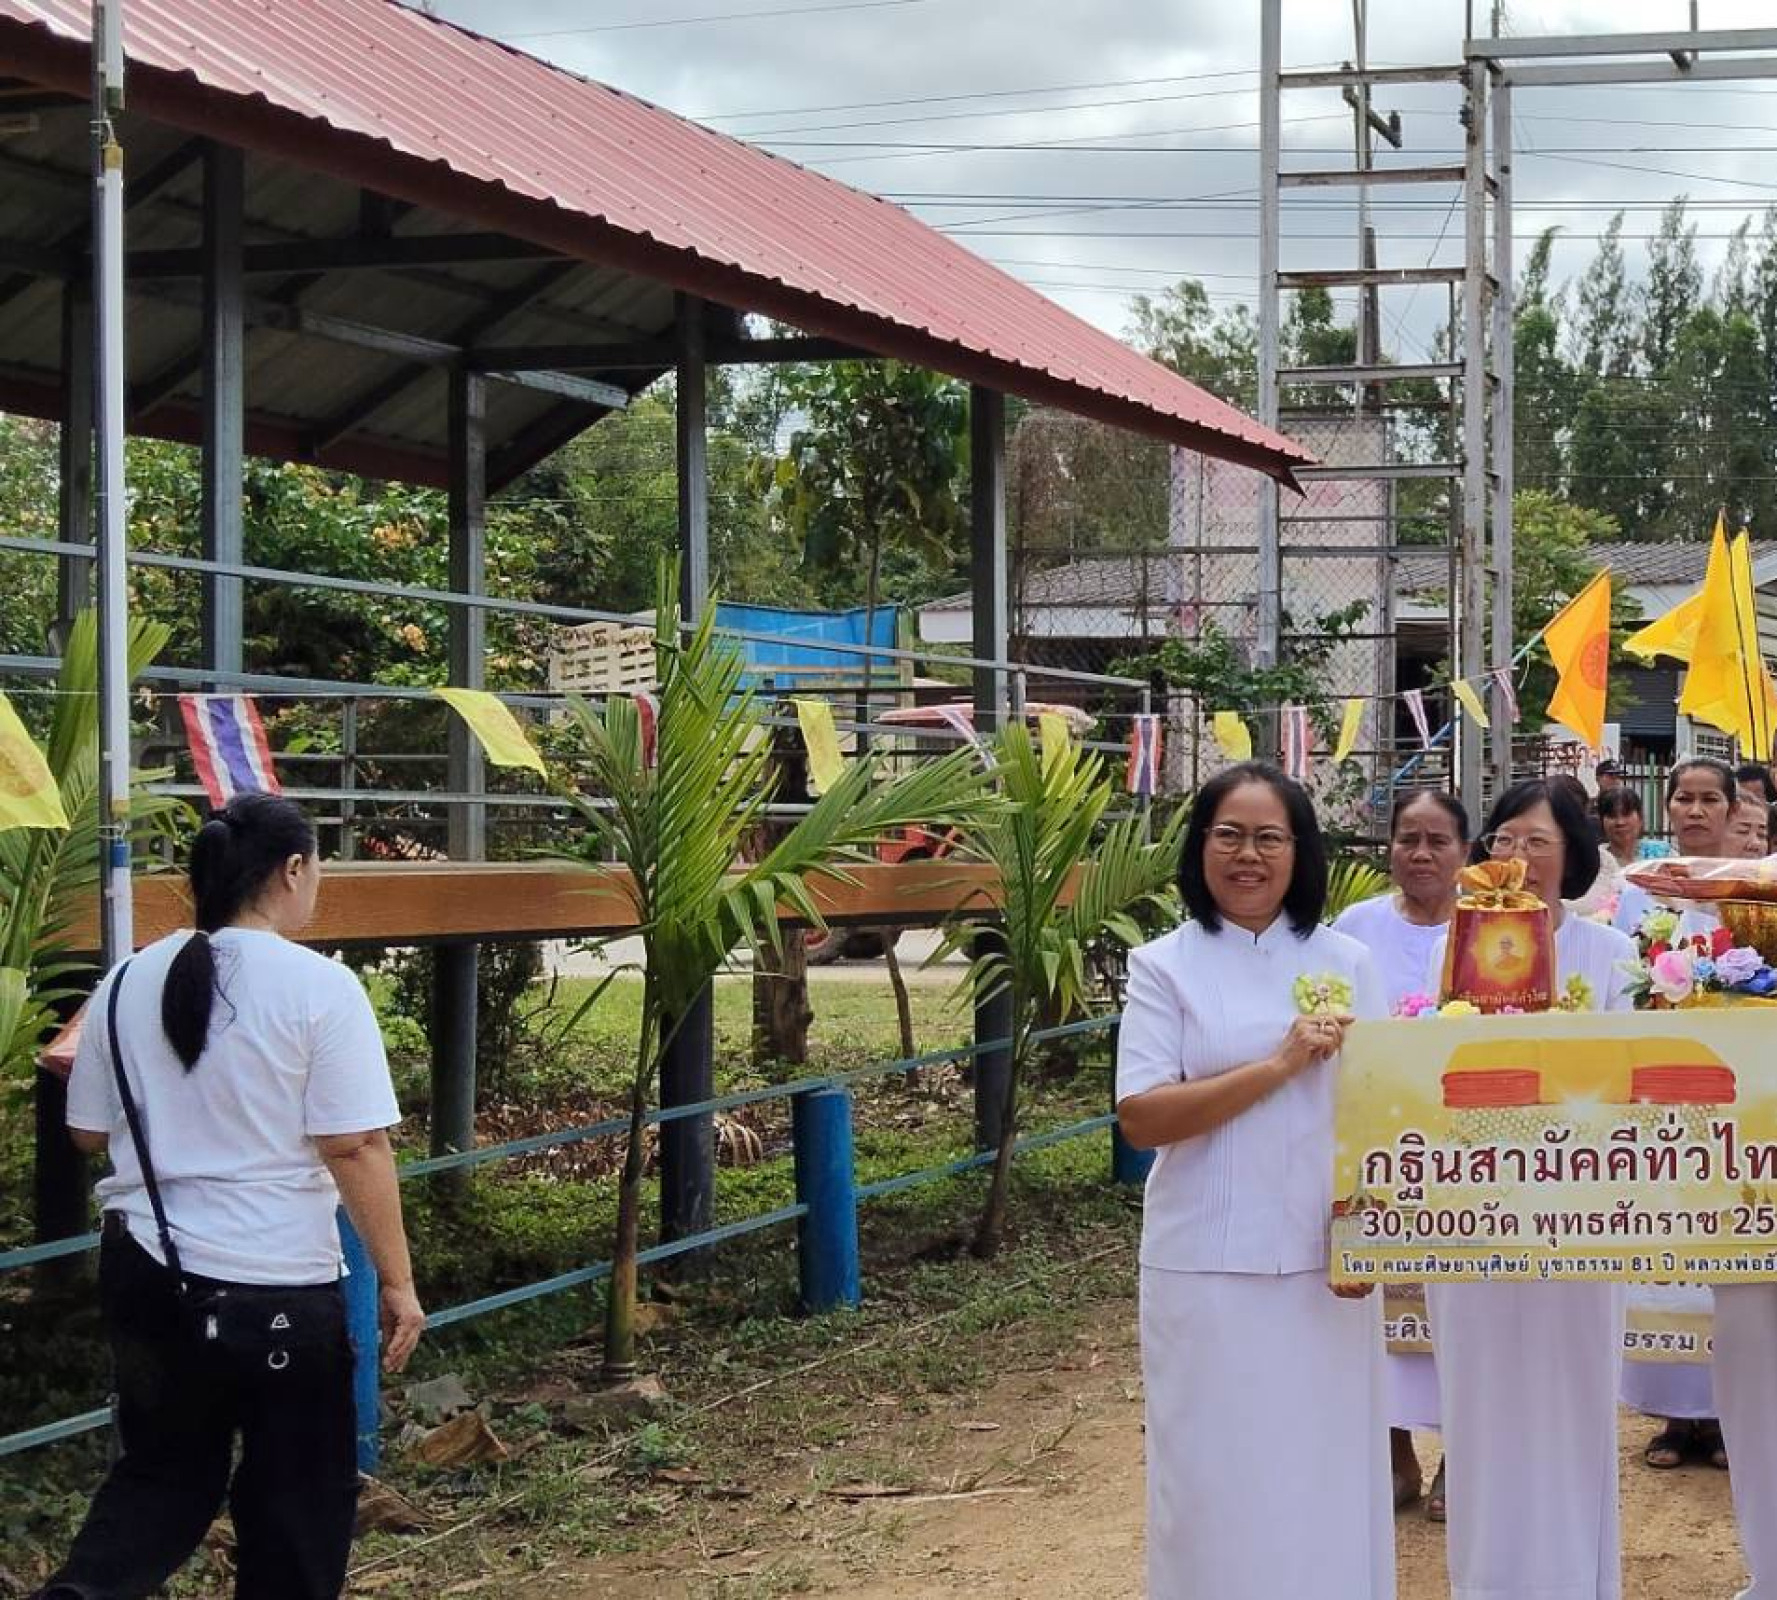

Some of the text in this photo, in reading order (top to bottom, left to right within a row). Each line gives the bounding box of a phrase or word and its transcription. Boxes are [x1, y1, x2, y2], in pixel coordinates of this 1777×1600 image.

[1363, 1202, 1520, 1242] 30,000วัด
[1532, 1200, 1719, 1248] พุทธศักราช
[1342, 1253, 1376, 1273] โดย
[1382, 1253, 1530, 1278] คณะศิษยานุศิษย์
[1538, 1258, 1624, 1278] บูชาธรรม
[1631, 1255, 1654, 1272] 81
[1662, 1252, 1676, 1272] ปี
